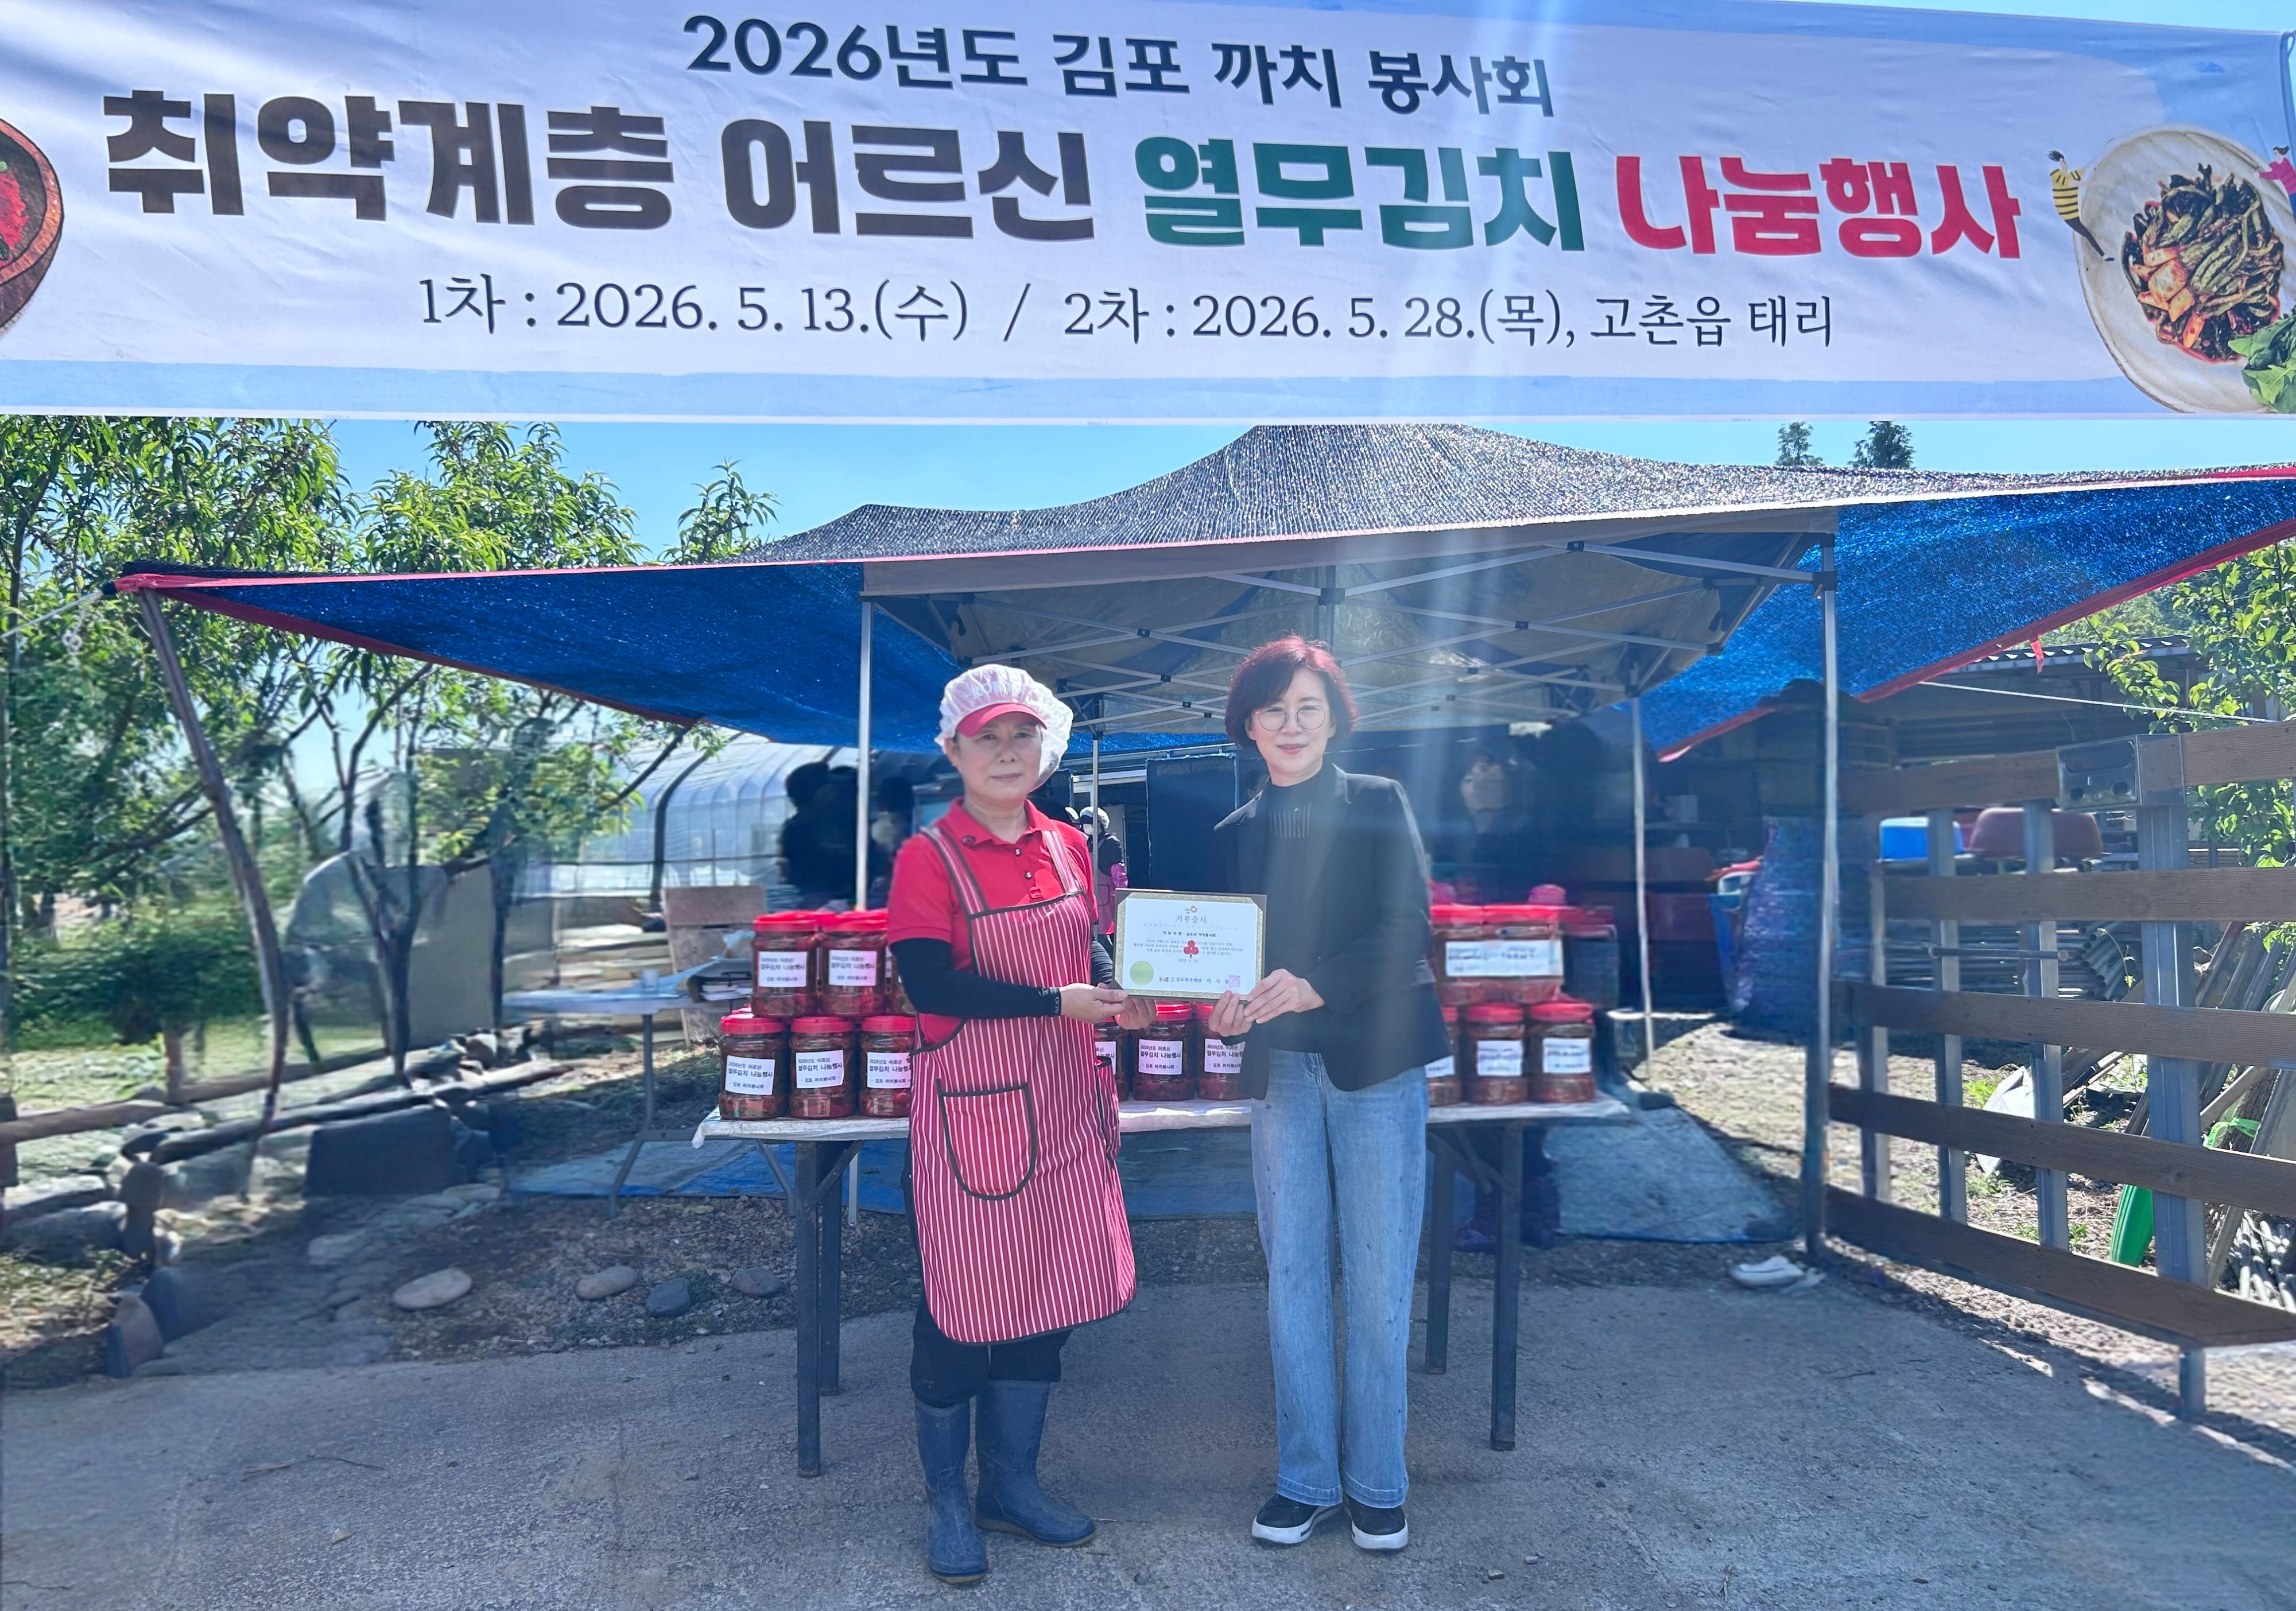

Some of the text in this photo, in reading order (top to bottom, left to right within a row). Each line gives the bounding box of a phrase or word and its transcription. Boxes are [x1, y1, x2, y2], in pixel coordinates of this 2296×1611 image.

[684, 15, 1553, 117] 2026년도 김포 까치 봉사회
[103, 90, 2021, 258] 취약계층 어르신 열무김치 나눔행사
[420, 273, 506, 334] 1차
[1065, 288, 1149, 344] 2차
[1591, 294, 1731, 347] 고촌읍
[1748, 295, 1830, 347] 태리
